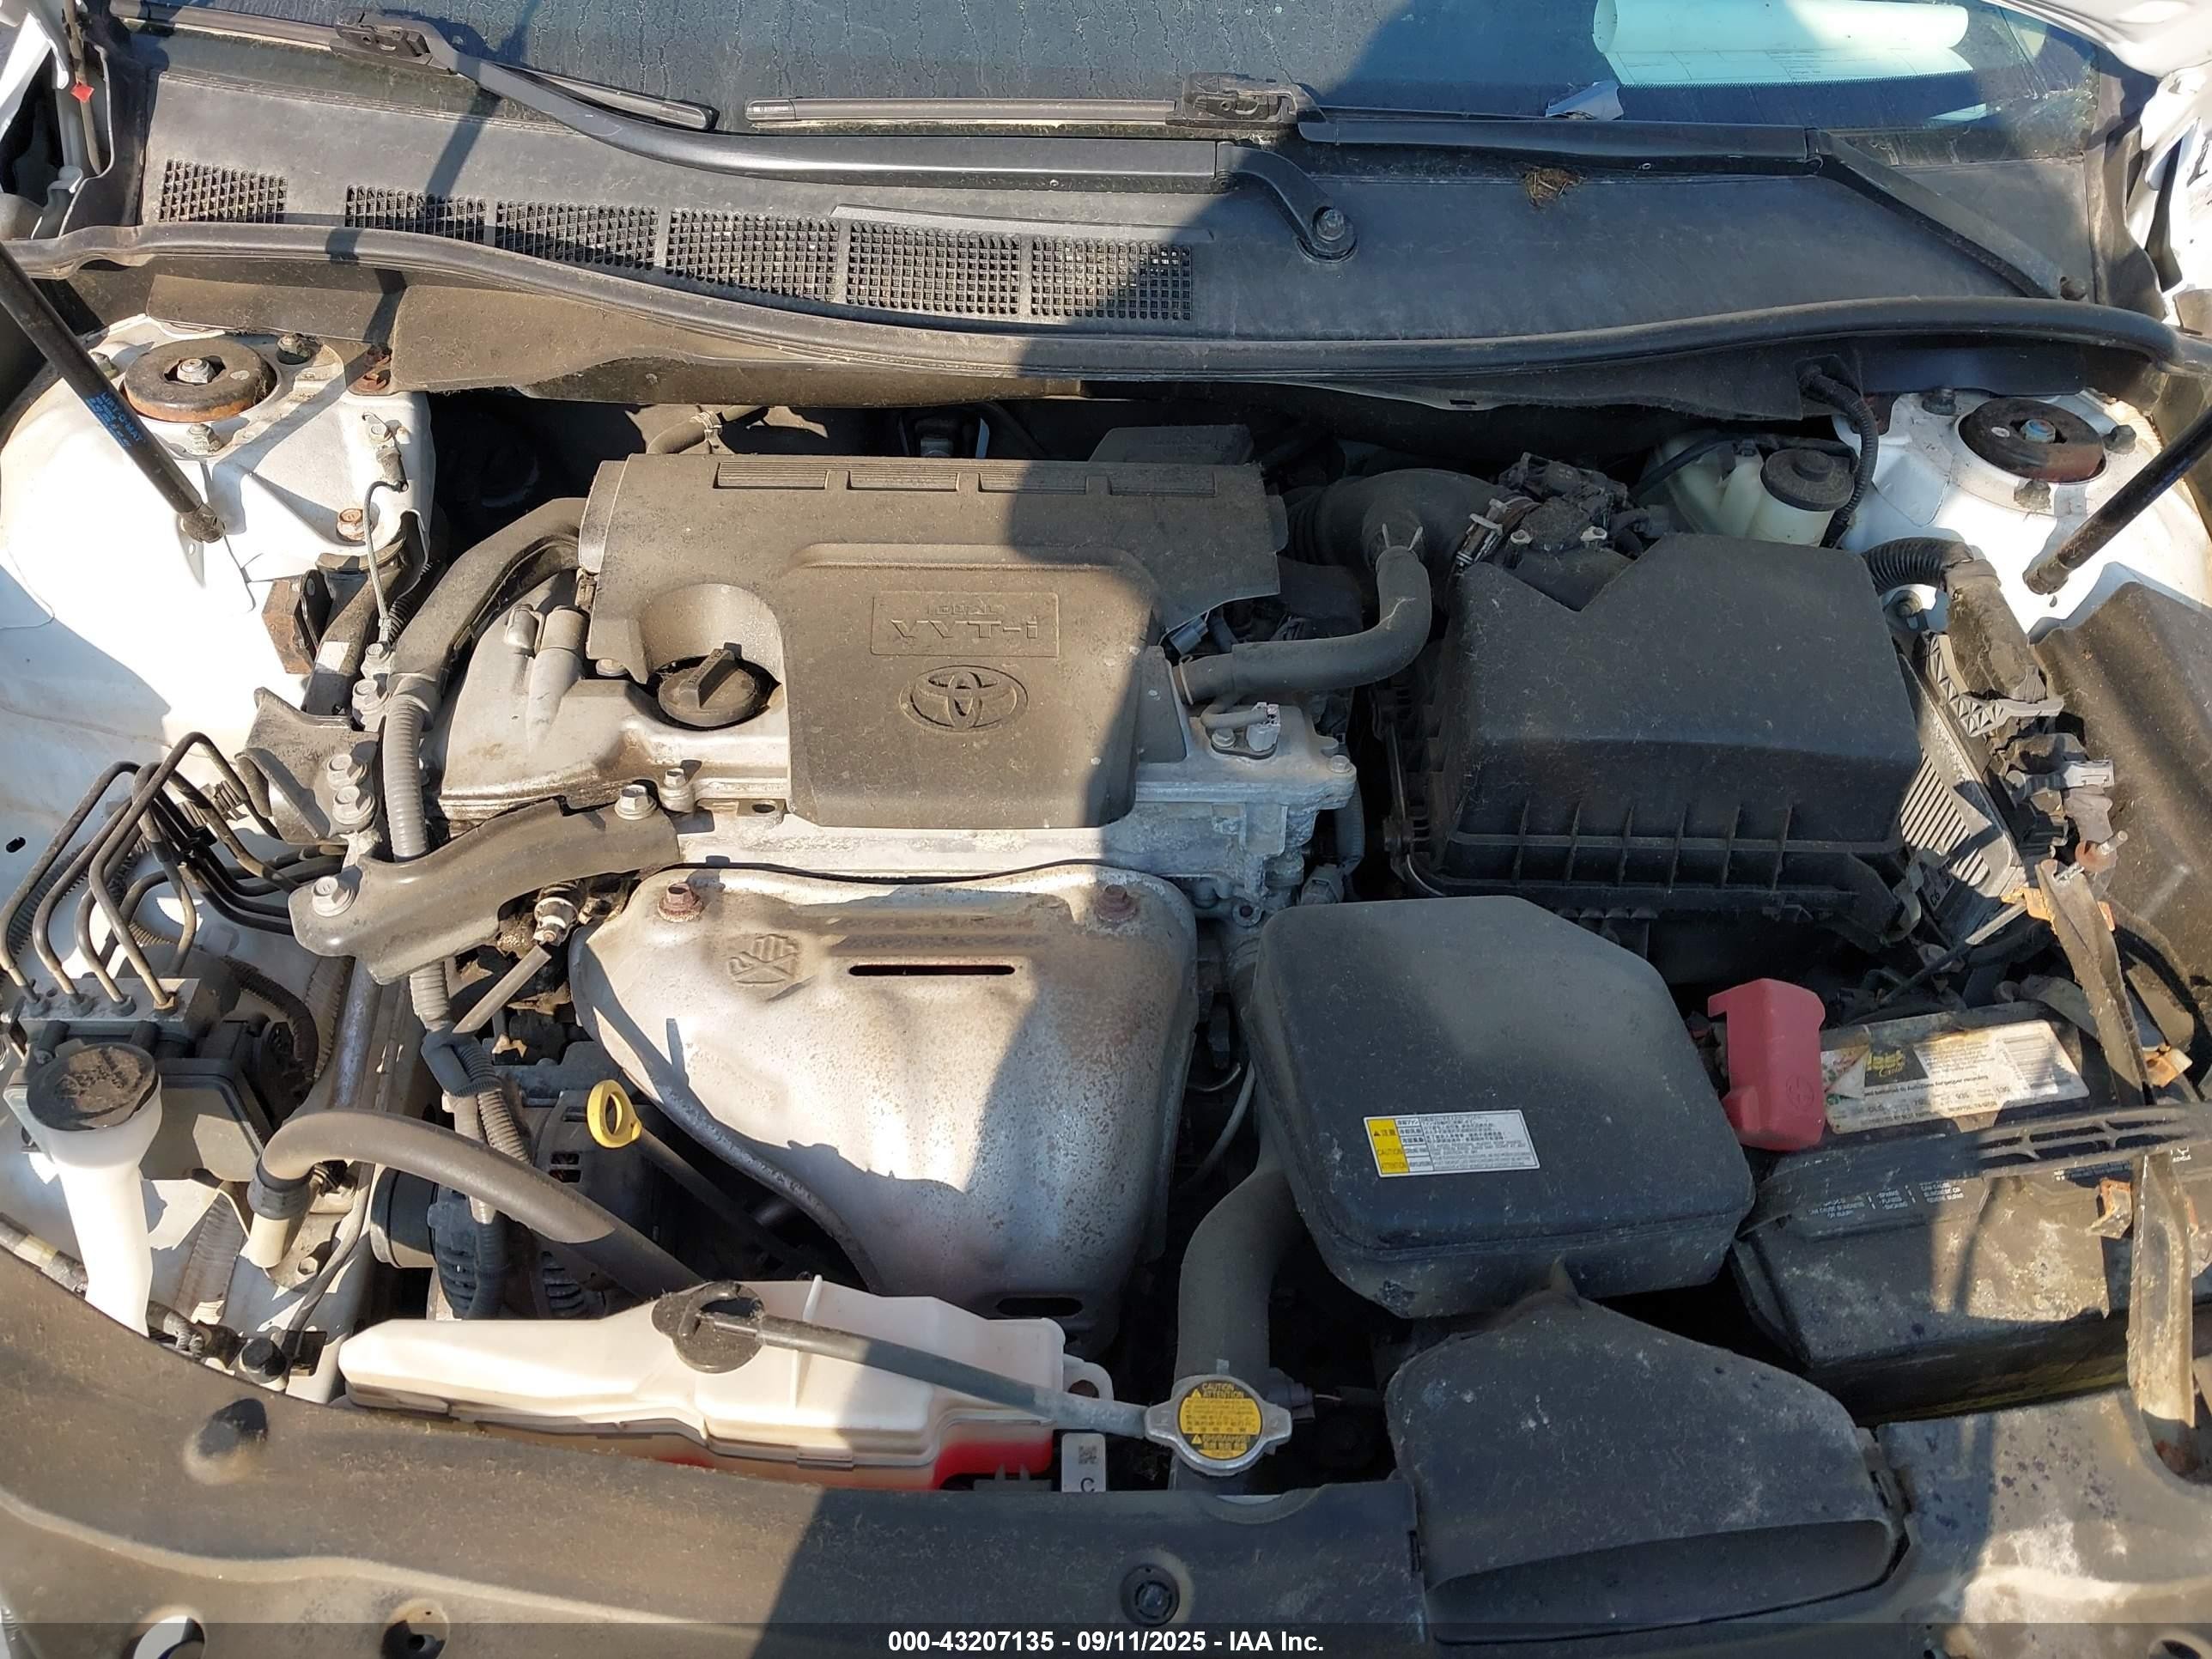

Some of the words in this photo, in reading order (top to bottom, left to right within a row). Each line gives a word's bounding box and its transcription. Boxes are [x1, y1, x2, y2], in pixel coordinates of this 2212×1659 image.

[890, 617, 1038, 640] VVT-i
[1201, 1382, 1235, 1392] CAUTION
[1202, 1391, 1244, 1400] ATTENTION
[1080, 1477, 1095, 1492] C
